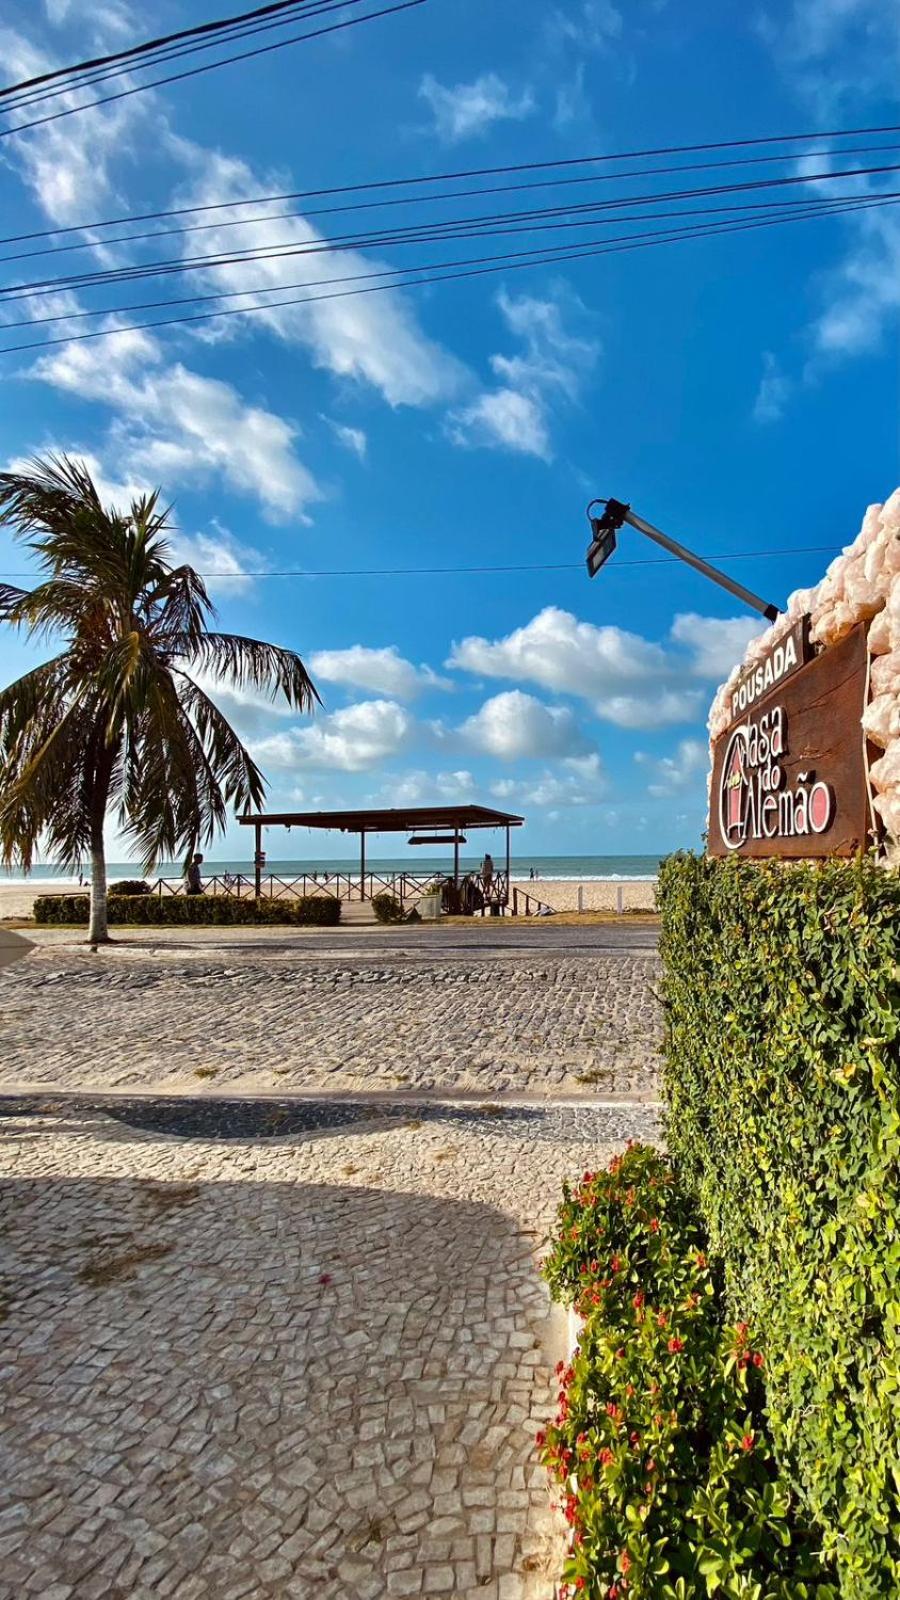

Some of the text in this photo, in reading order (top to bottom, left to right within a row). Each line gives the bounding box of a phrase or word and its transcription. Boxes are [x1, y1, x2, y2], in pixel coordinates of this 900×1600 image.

[732, 635, 798, 718] POUSADA
[742, 767, 831, 839] Alemão
[762, 753, 781, 792] do
